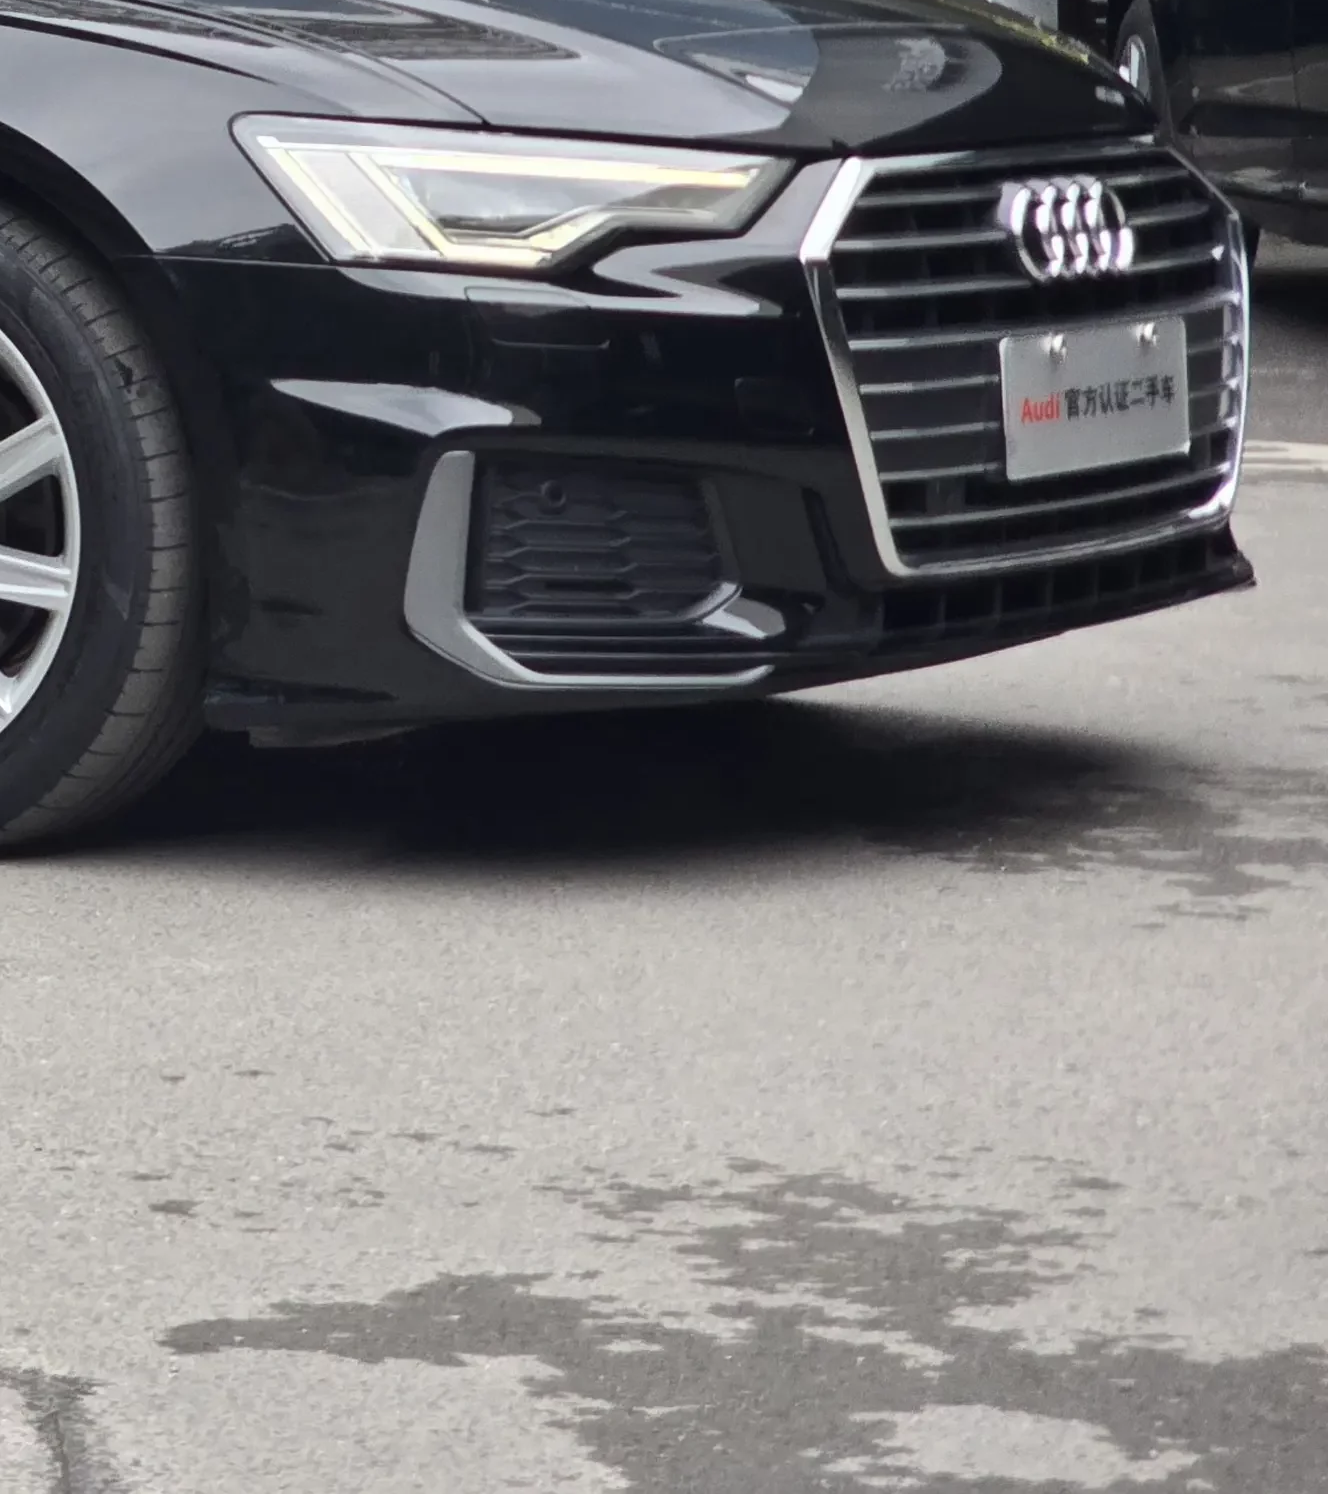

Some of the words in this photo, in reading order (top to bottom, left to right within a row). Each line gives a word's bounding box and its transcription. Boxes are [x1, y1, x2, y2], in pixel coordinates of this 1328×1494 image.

[1021, 393, 1060, 424] Audi
[1065, 374, 1175, 421] 官方认证二手车
